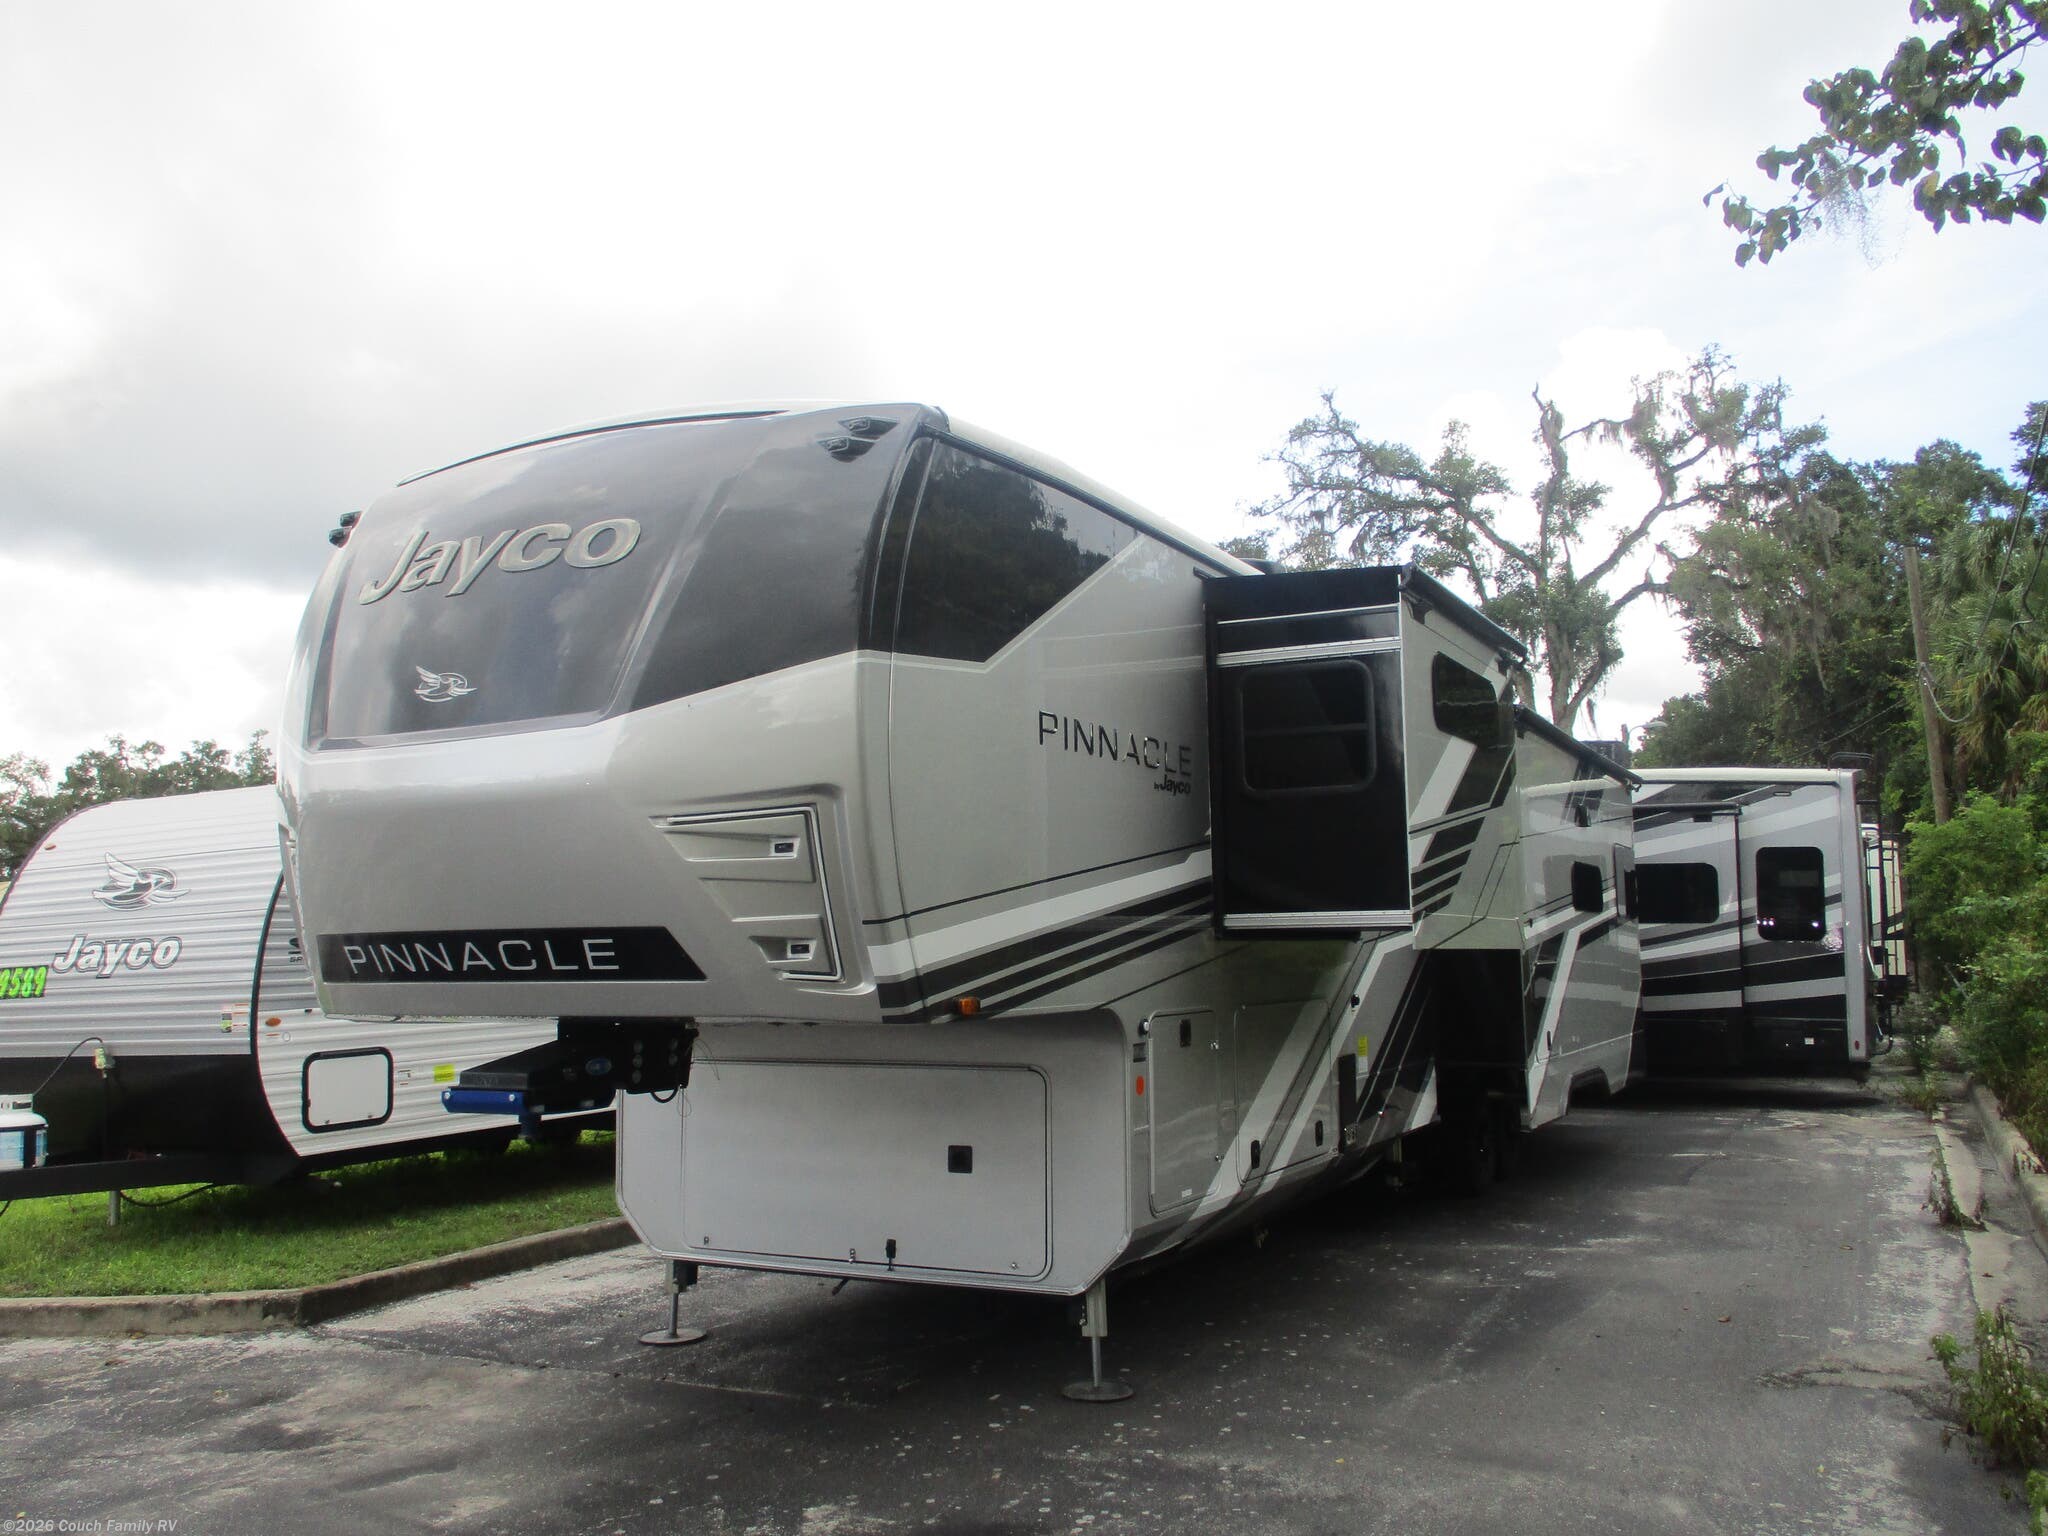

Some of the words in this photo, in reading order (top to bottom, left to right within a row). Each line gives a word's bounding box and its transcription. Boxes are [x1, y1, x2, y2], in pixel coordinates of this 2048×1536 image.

[359, 518, 642, 605] Jayco
[1038, 709, 1192, 777] PINNACLE
[1160, 774, 1192, 796] Jayco
[52, 933, 183, 979] Jayco
[343, 938, 620, 975] PINNACLE
